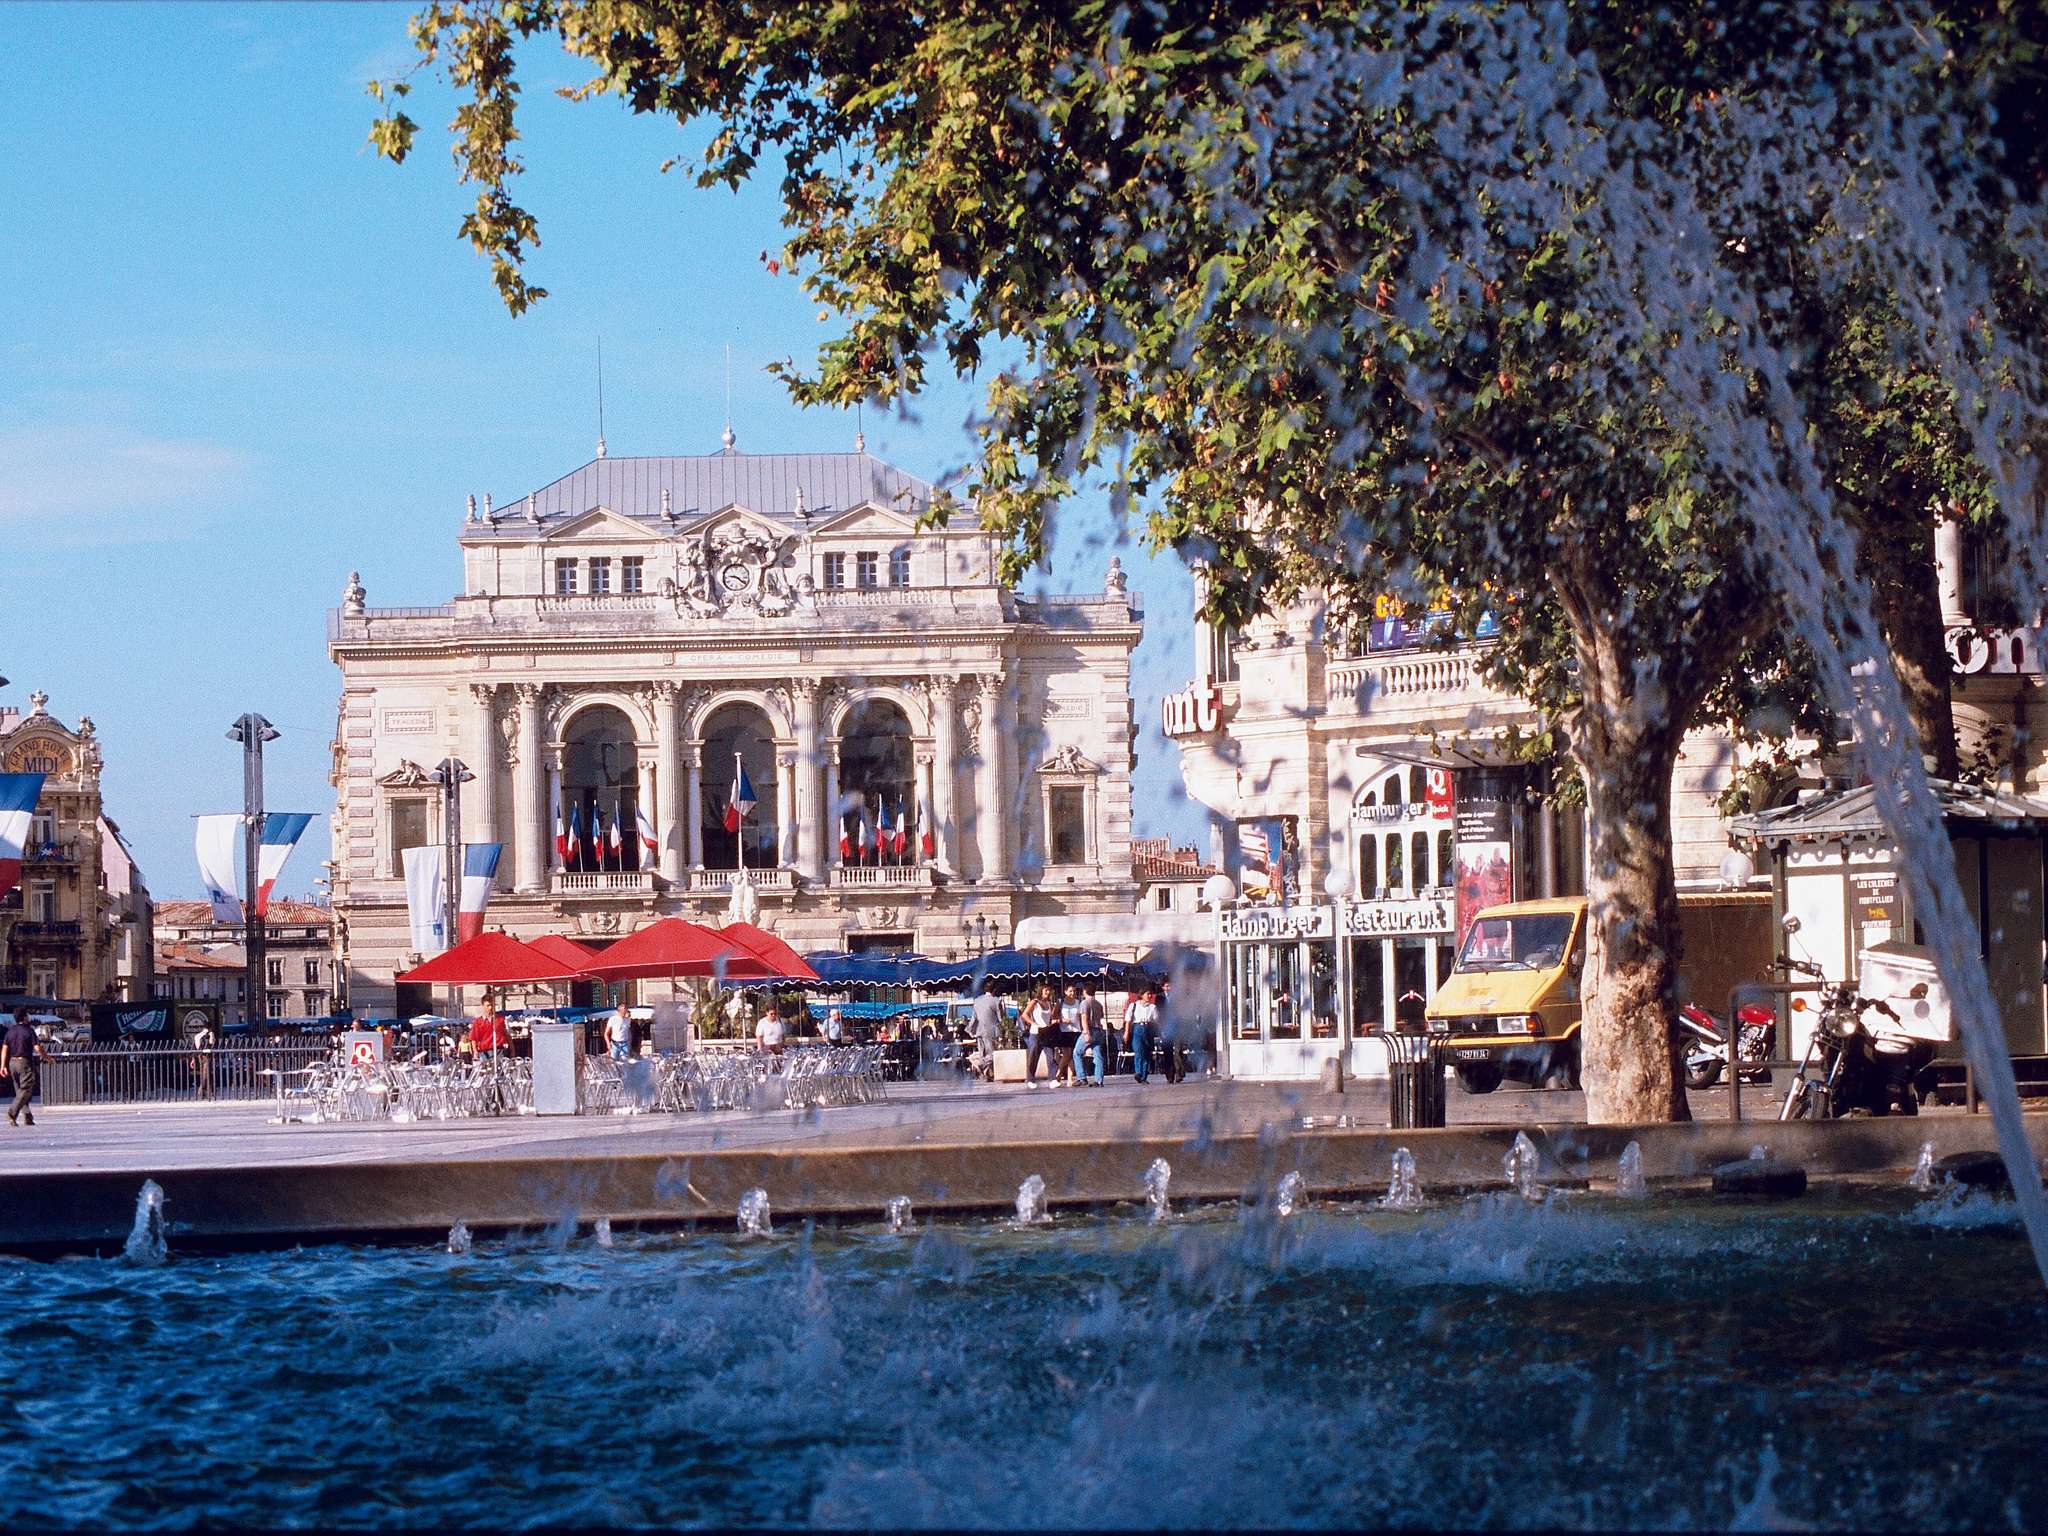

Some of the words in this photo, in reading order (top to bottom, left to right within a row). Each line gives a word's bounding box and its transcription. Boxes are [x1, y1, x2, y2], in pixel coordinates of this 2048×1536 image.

[24, 757, 59, 773] MIDI
[1350, 801, 1425, 821] Hamburger
[1858, 895, 1894, 905] MONTPELLIER
[1219, 909, 1317, 939] Hamburger
[1344, 903, 1446, 932] Restaurant
